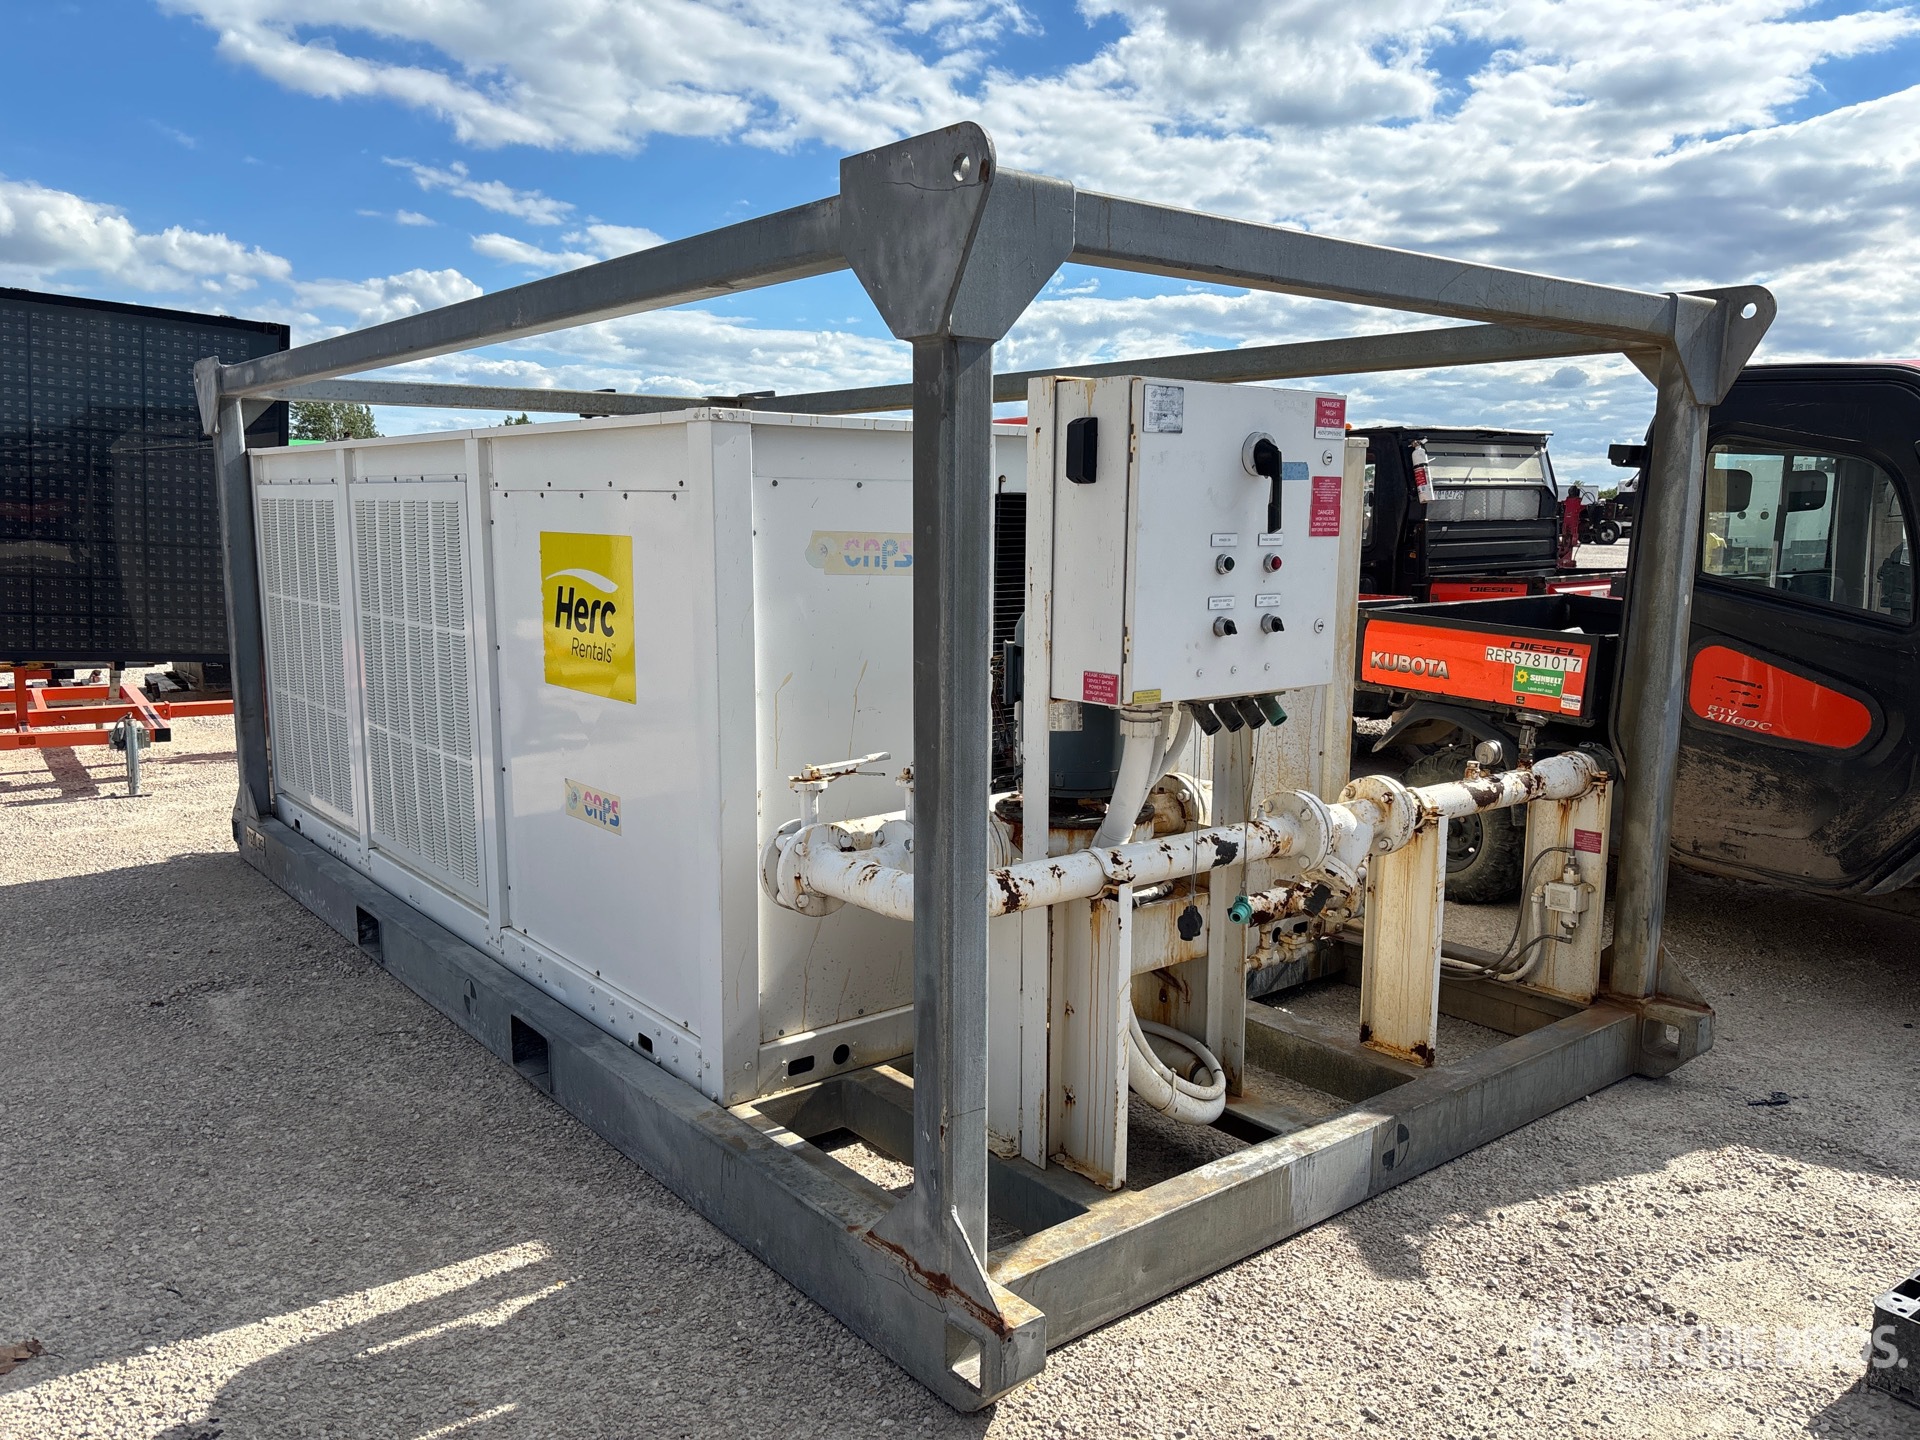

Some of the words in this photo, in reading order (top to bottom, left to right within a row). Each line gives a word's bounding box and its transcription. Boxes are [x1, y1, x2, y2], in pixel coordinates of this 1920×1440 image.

[1321, 400, 1341, 408] DANGER
[1320, 417, 1341, 425] VOLTAGE
[555, 586, 616, 637] Herc
[571, 637, 612, 663] Rentals
[1510, 641, 1580, 657] DIESEL
[1370, 651, 1449, 679] KUBOTA
[1486, 648, 1581, 671] RER5781017
[1530, 674, 1562, 685] SUNBELT
[1708, 705, 1737, 715] RTV
[1704, 711, 1772, 730] X1100C
